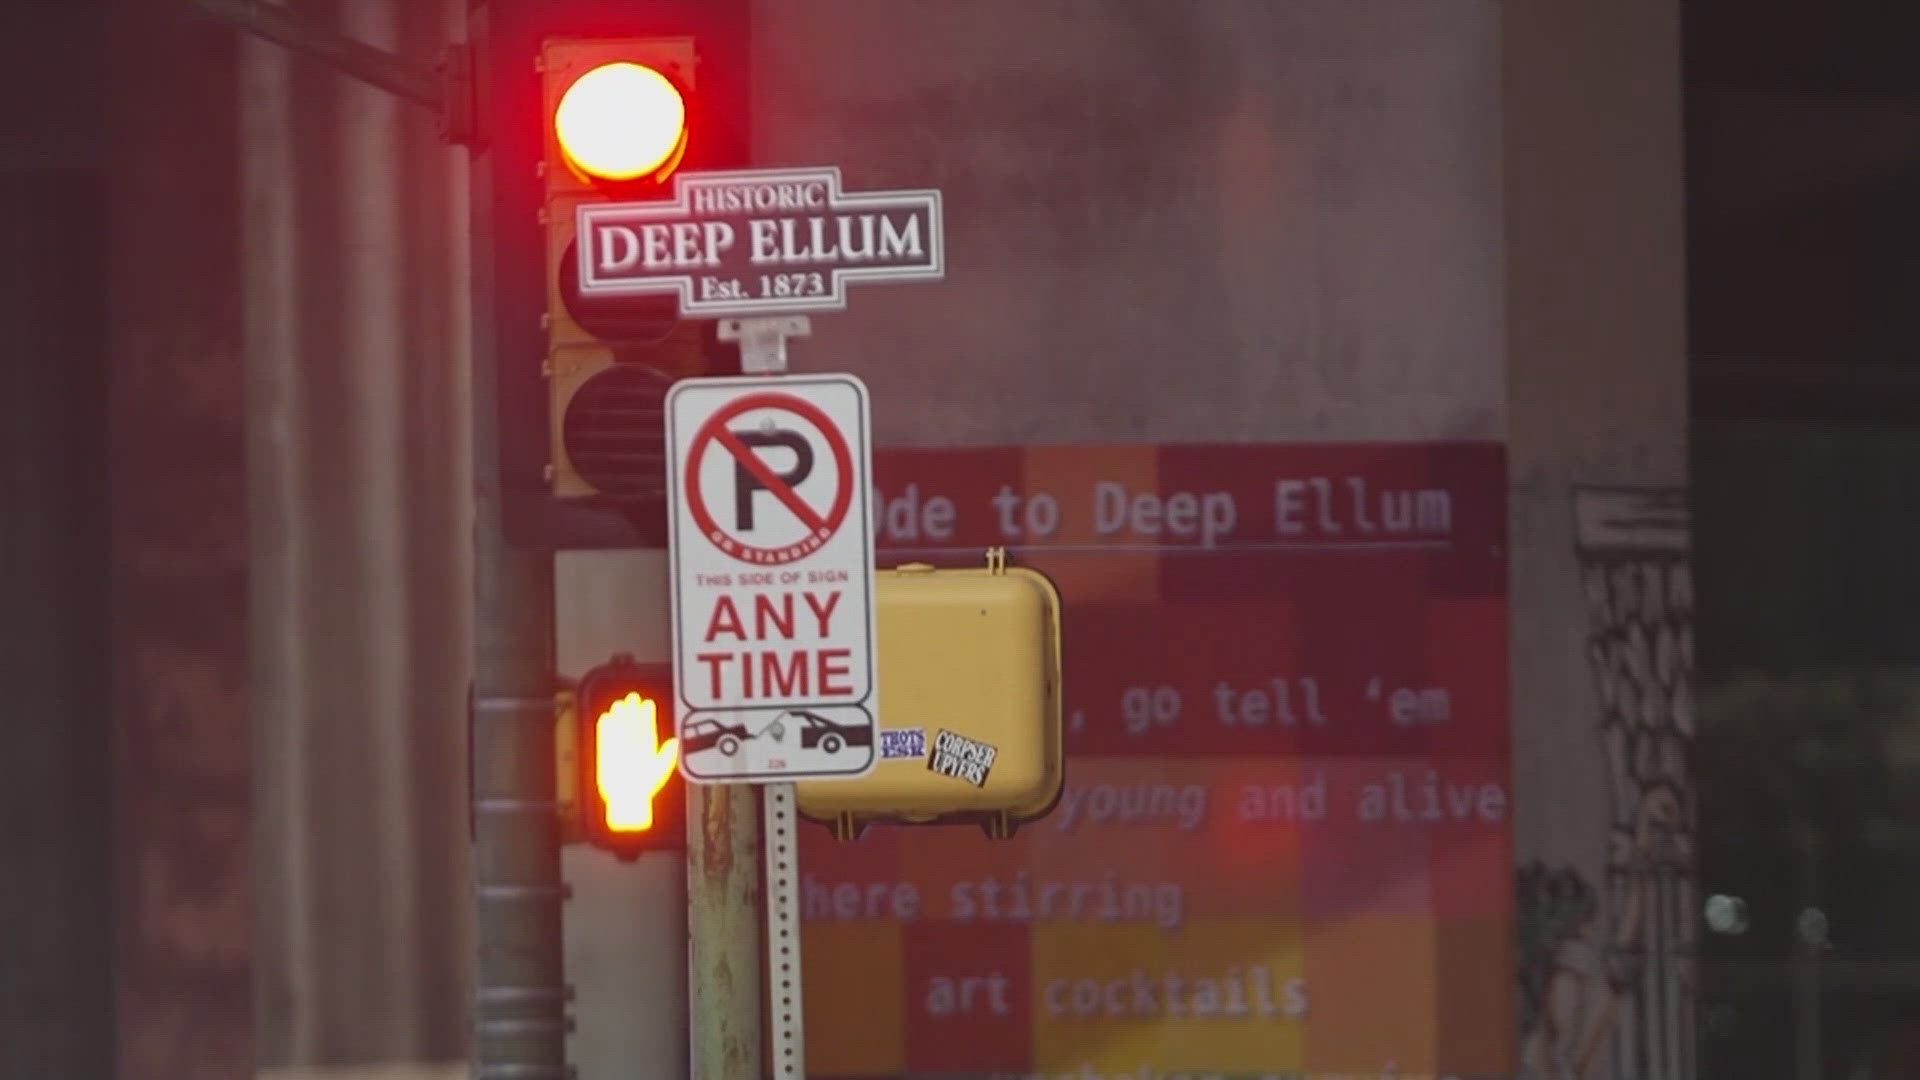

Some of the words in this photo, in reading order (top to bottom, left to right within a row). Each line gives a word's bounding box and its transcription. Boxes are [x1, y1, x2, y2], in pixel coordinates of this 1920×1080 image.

[694, 183, 824, 212] HISTORIC
[599, 221, 734, 270] DEEP
[750, 213, 924, 262] ELLUM
[702, 276, 748, 300] Est.
[760, 274, 823, 298] 1873
[733, 430, 814, 531] P
[991, 485, 1059, 536] to
[1094, 483, 1236, 548] Deep
[1275, 478, 1453, 533] Ellum
[711, 531, 734, 550] OR
[742, 527, 831, 562] STANDING
[696, 574, 732, 587] THIS
[738, 573, 774, 586] SIDE
[780, 572, 801, 585] OF
[807, 570, 848, 584] SIGN
[705, 591, 841, 642] ANY
[696, 648, 853, 700] TIME
[1121, 685, 1182, 735] go
[1213, 676, 1328, 727] tell
[935, 730, 996, 767] CORPSER
[1056, 782, 1208, 831] young
[1237, 773, 1327, 821] and
[1358, 770, 1508, 823] alive
[950, 871, 1182, 930] stirring
[925, 973, 1011, 1016] art
[1045, 965, 1310, 1017] cocktails
